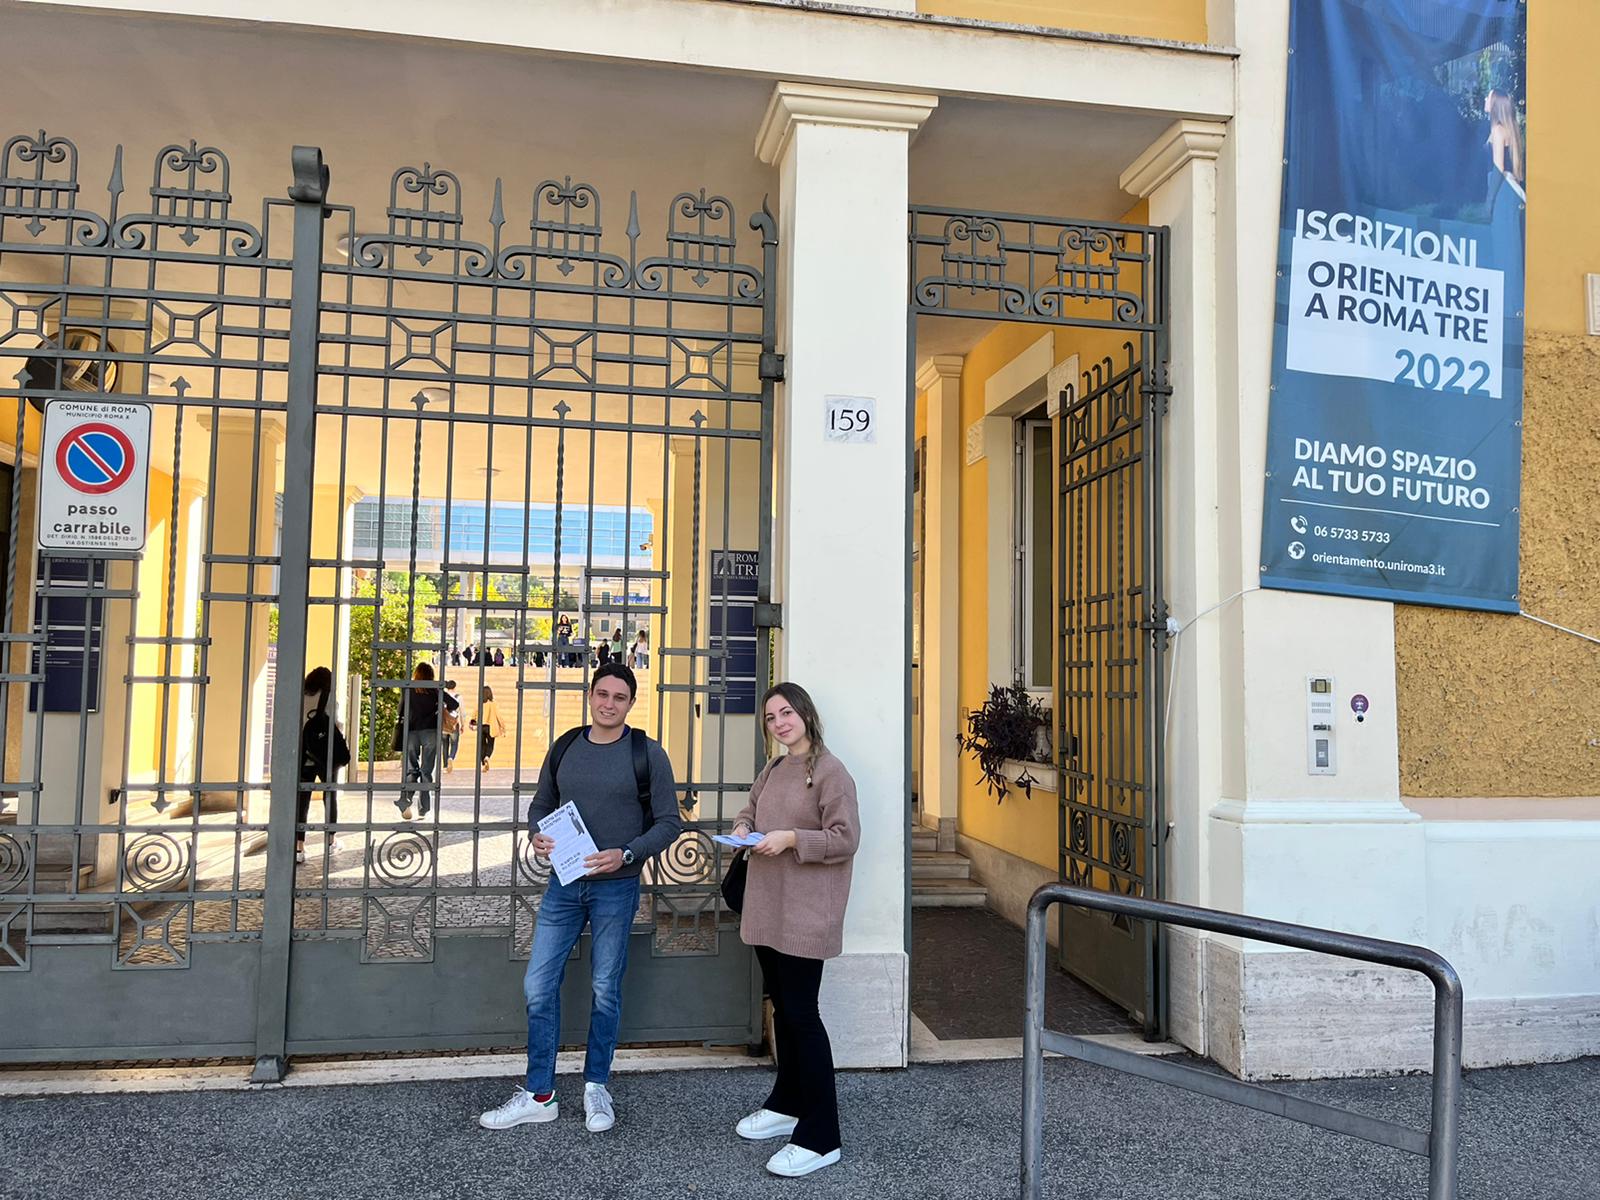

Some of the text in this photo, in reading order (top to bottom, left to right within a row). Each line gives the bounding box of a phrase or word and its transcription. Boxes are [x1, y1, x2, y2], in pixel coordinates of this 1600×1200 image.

[1296, 208, 1477, 268] ISCRIZIONI
[1307, 260, 1489, 314] ORIENTARSI
[1304, 293, 1489, 344] A ROMA TRE
[1394, 348, 1491, 397] 2022
[60, 404, 98, 412] COMUNE
[111, 406, 137, 414] ROMA
[831, 409, 870, 432] 159
[1294, 437, 1476, 481] DIAMO SPAZIO
[1292, 466, 1490, 510] AL TUO FUTURO
[67, 504, 118, 516] passo
[53, 522, 131, 535] carrabile
[1313, 525, 1391, 544] 06 5733 5733
[736, 553, 758, 563] ROM
[1312, 552, 1446, 577] orientamento.uniroma3.it
